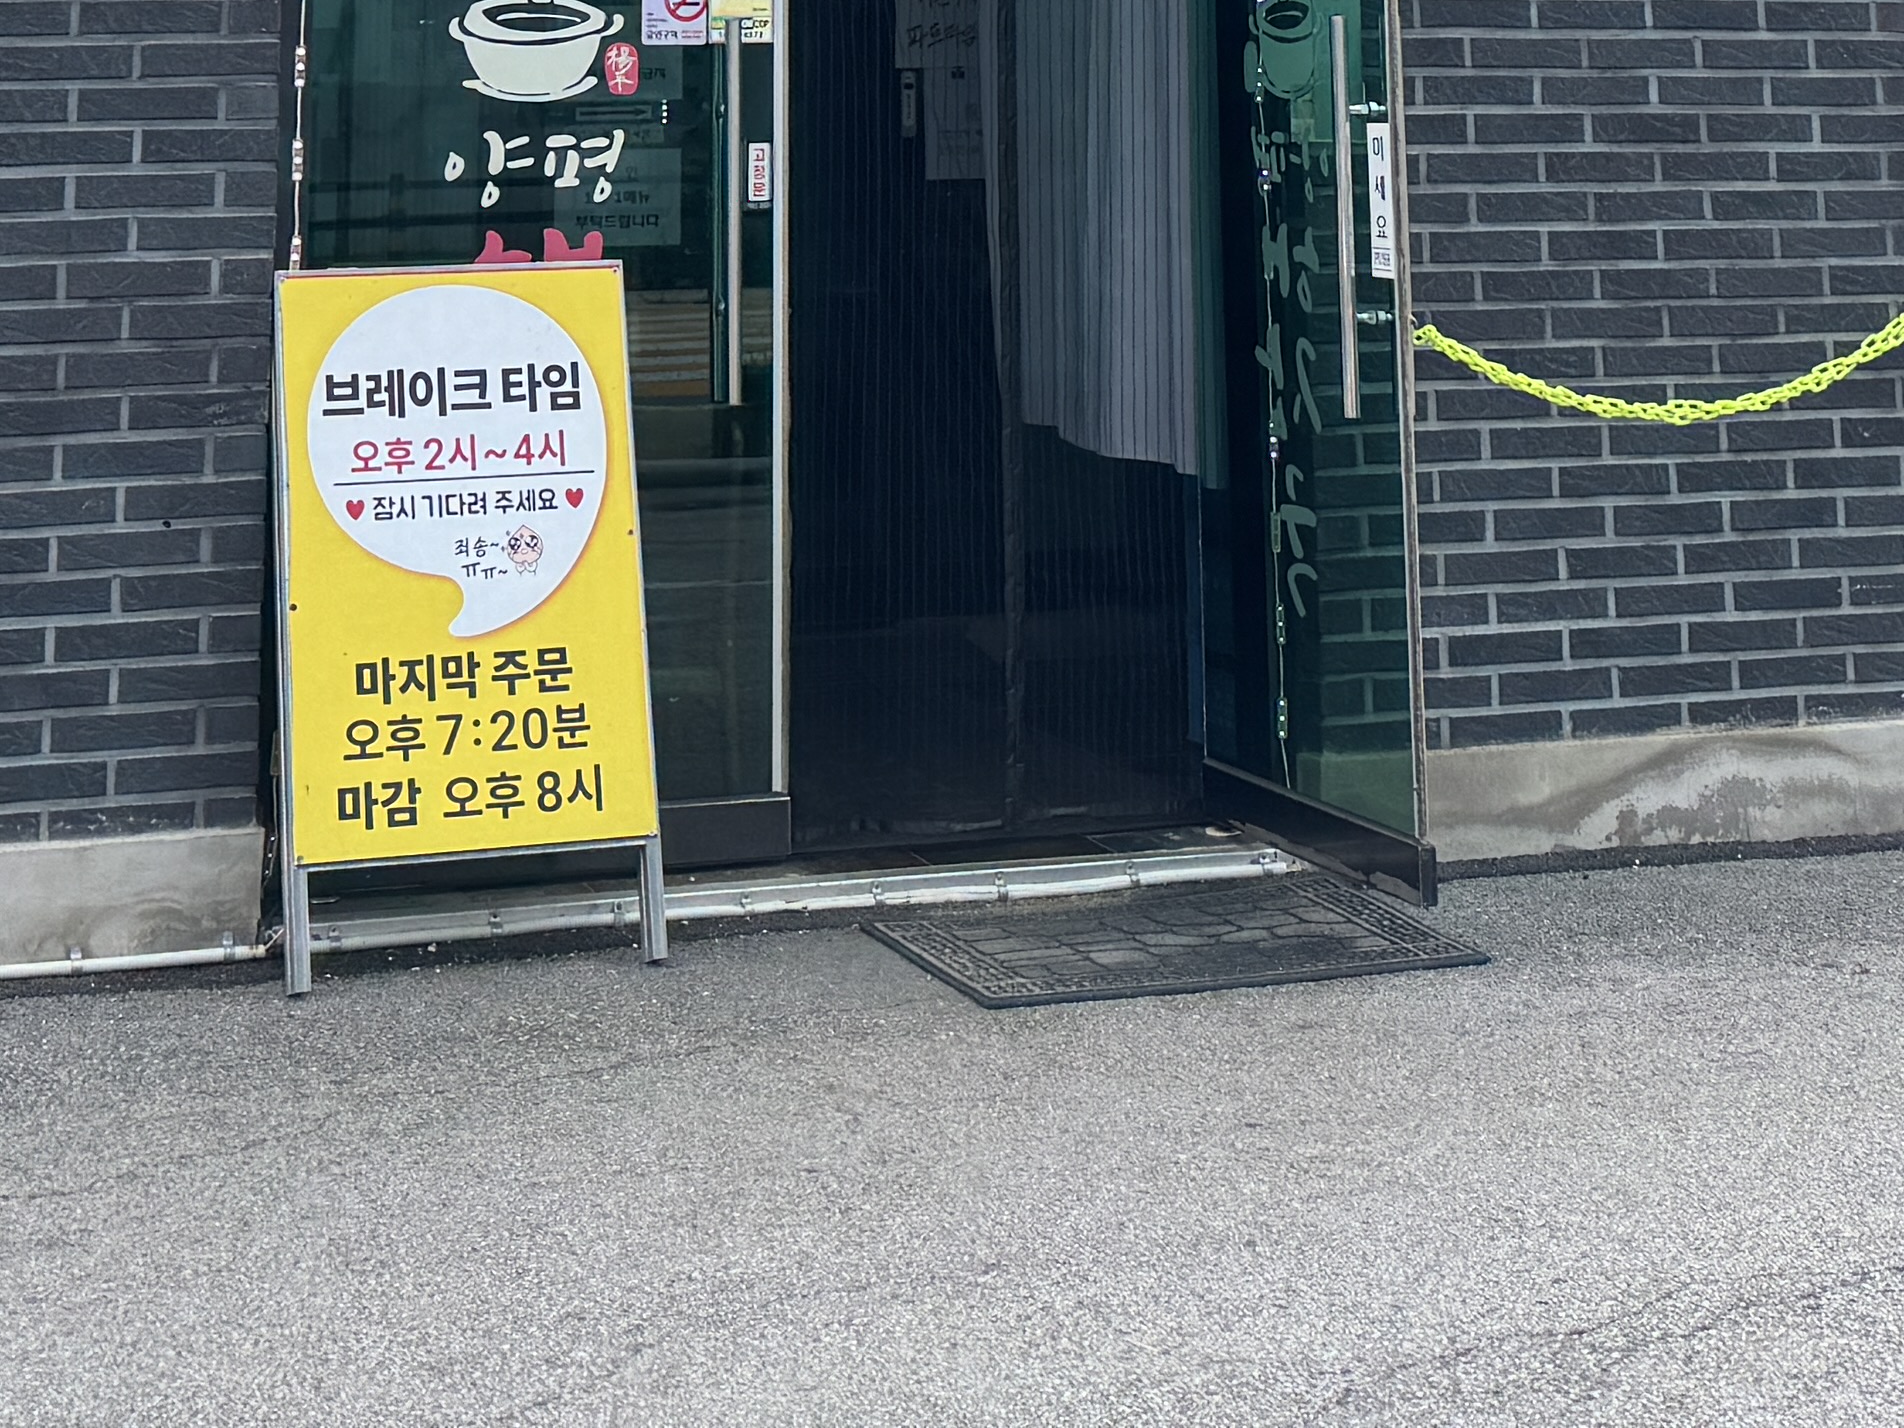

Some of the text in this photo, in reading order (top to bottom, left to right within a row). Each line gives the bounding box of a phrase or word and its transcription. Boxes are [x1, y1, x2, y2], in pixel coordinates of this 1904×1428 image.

[444, 129, 626, 209] 양평
[1372, 135, 1389, 239] 미세요
[576, 214, 659, 230] 부탁드립니다
[322, 361, 582, 418] 브레이크 타임
[351, 437, 416, 474] 오후
[372, 488, 559, 521] 잠시 기다려 주세요
[355, 647, 574, 705] 마지막 주문
[343, 702, 591, 762] 오후 7:20분
[337, 764, 604, 830] 마감 오후 8시
